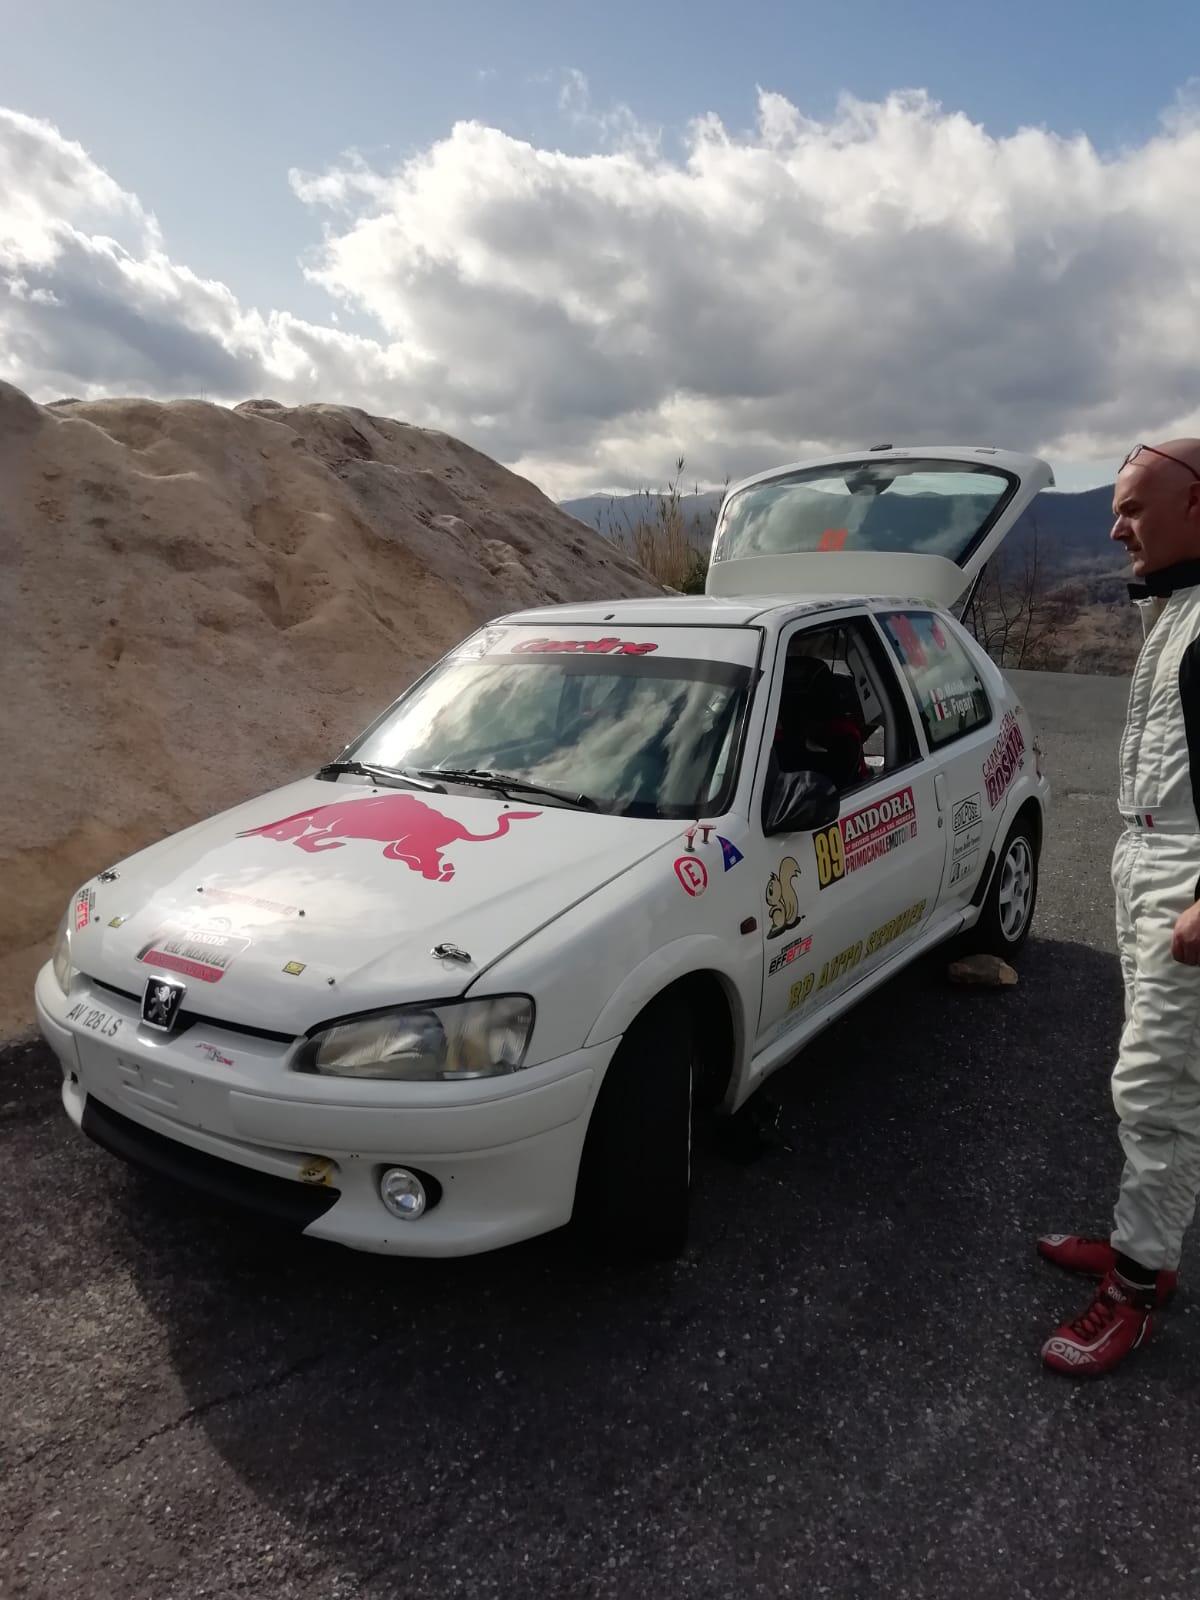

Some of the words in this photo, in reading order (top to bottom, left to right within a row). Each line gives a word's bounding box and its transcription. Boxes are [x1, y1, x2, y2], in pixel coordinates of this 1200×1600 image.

[986, 726, 1024, 808] ROSATA
[844, 791, 913, 843] ANDORA
[684, 863, 701, 887] E
[815, 826, 845, 886] 89
[66, 1003, 89, 1021] AV
[83, 1009, 106, 1030] 128
[101, 1015, 123, 1037] LS
